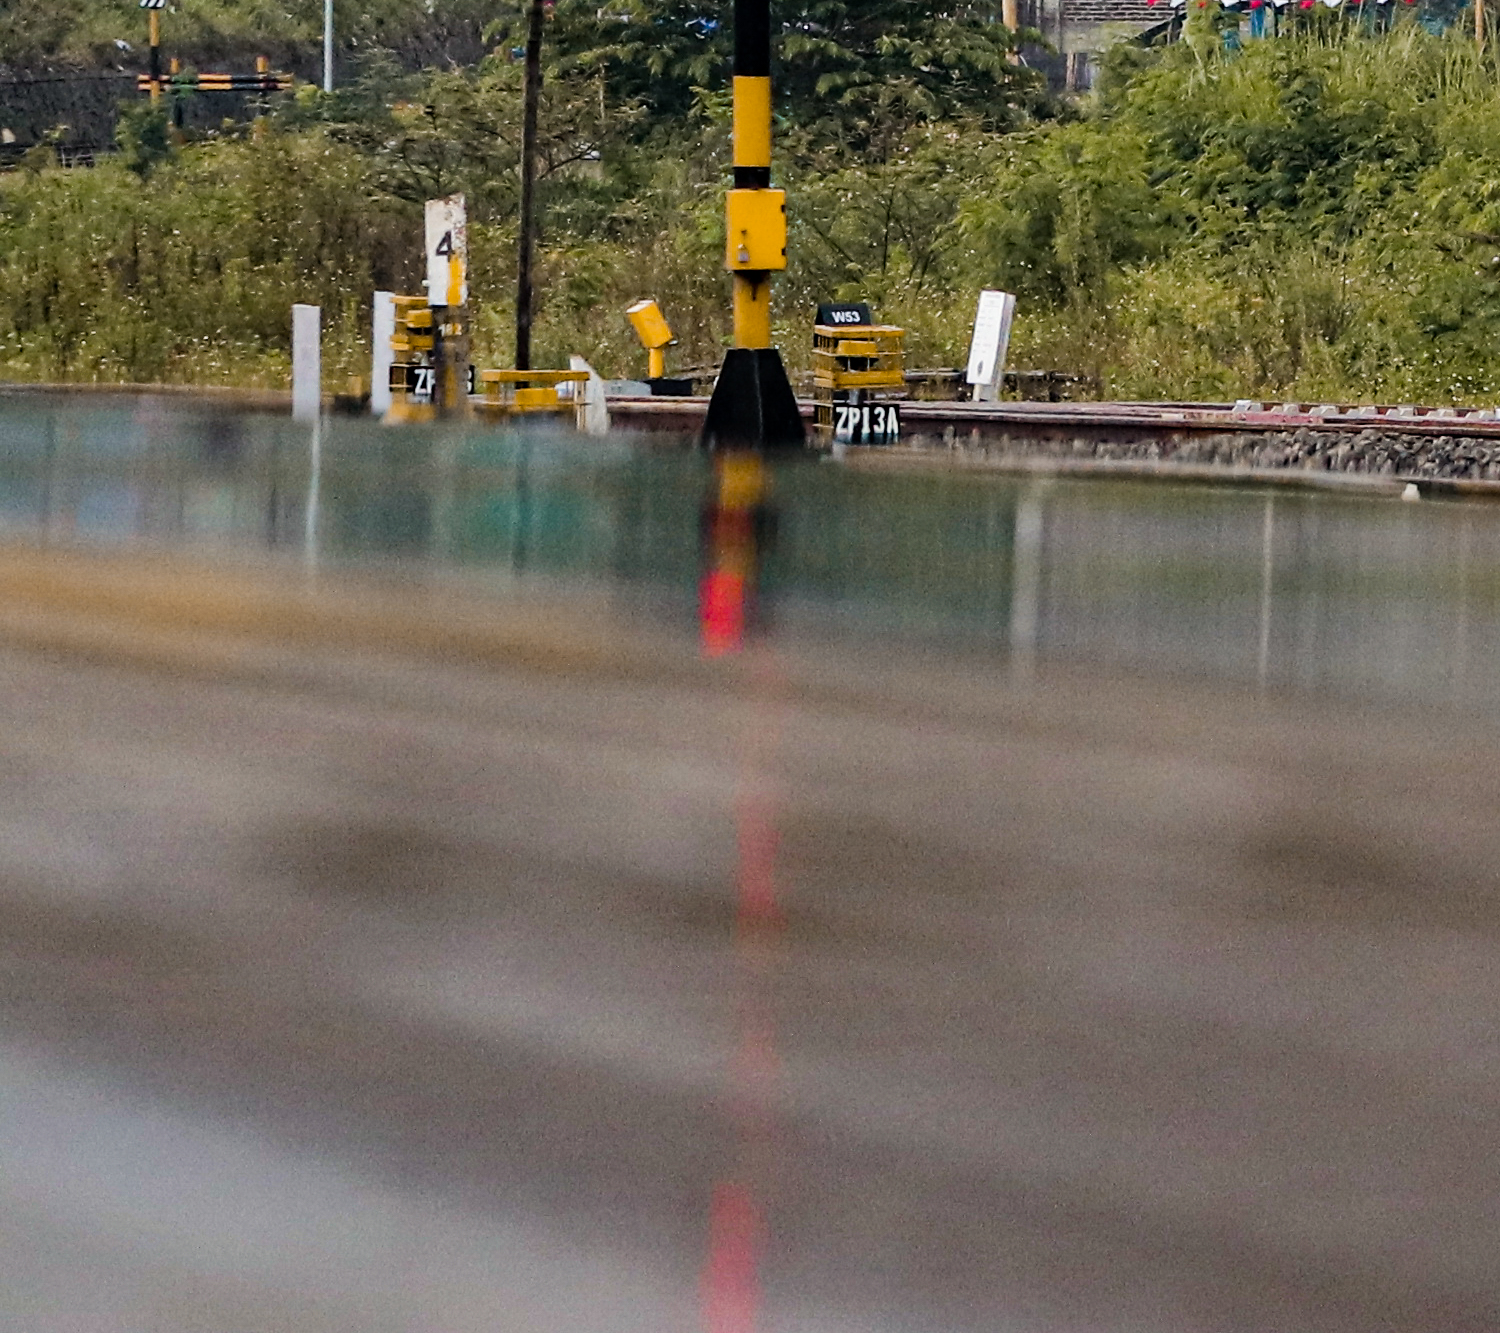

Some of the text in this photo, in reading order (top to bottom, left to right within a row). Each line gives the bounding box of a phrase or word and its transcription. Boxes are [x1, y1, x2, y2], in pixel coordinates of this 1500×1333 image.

[436, 230, 456, 262] 4
[832, 311, 860, 323] W53
[836, 407, 899, 437] ZP13A
